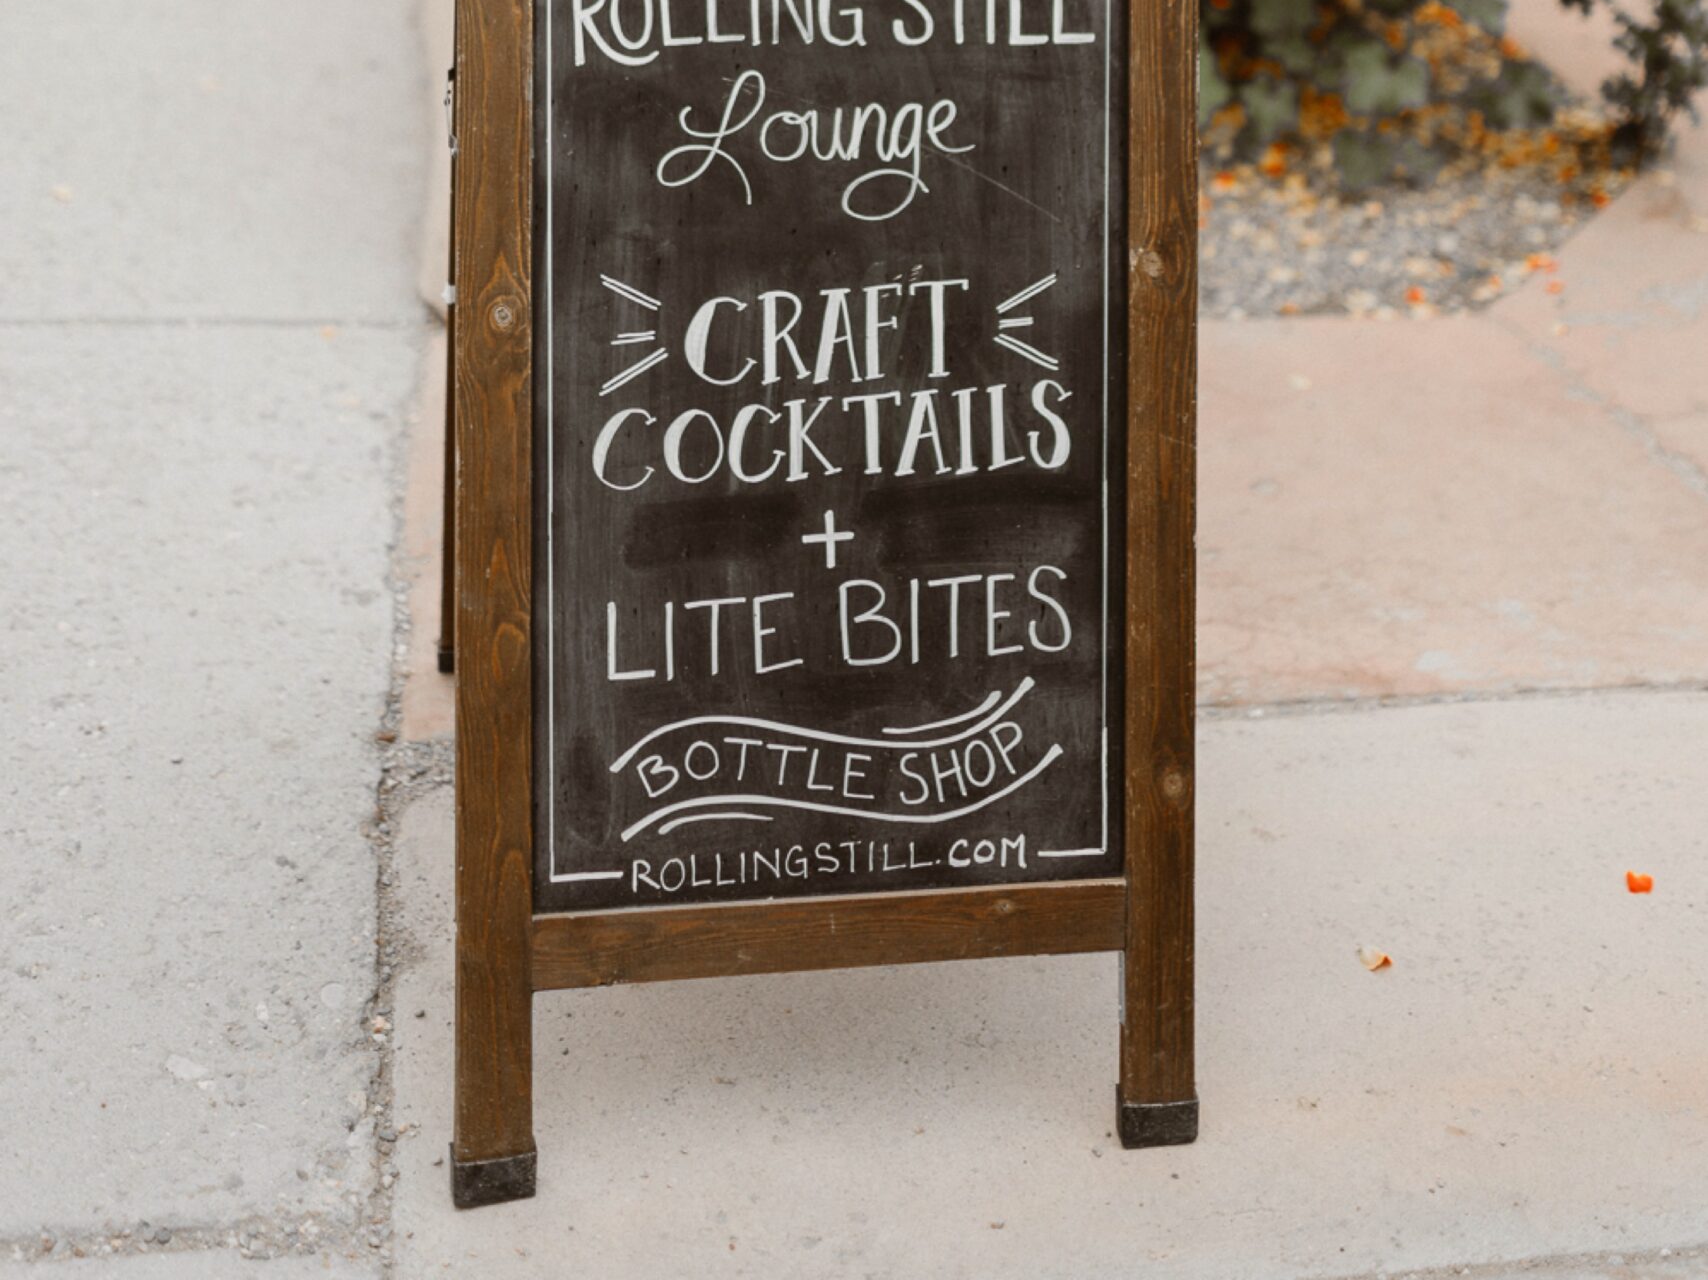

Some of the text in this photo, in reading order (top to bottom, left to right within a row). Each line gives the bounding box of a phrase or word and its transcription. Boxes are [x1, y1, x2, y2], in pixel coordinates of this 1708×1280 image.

[657, 69, 976, 221] Lounge
[683, 278, 969, 386] CRAFT
[591, 379, 1072, 491] COCKTAILS
[801, 509, 854, 569] +
[607, 565, 1072, 682] LITE BITES
[636, 721, 1025, 806] BOTTLE SHOP
[630, 832, 1028, 893] ROLLINGSTILL.COM
